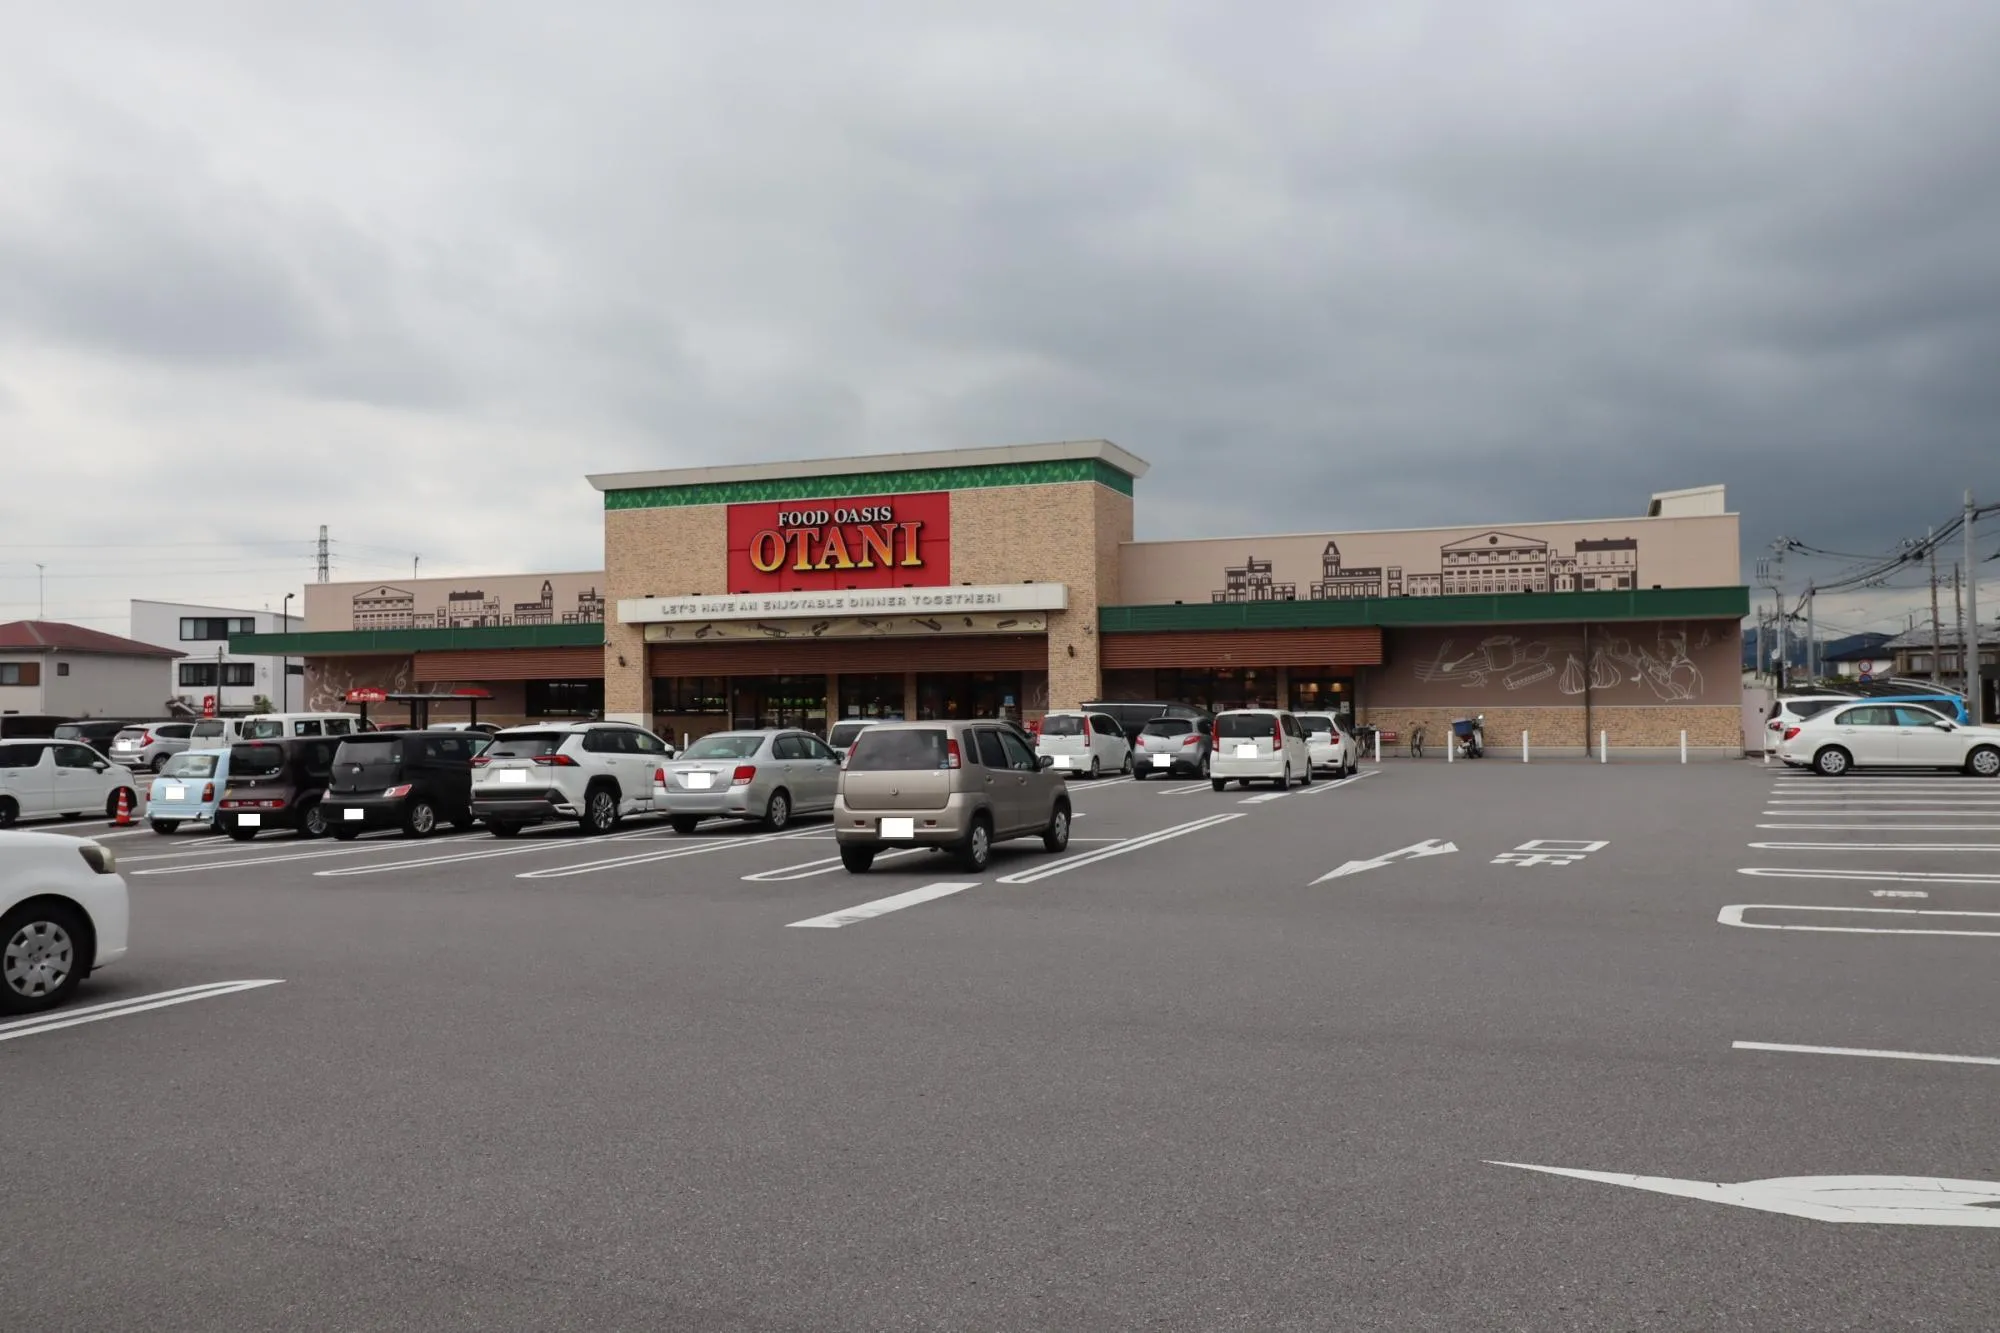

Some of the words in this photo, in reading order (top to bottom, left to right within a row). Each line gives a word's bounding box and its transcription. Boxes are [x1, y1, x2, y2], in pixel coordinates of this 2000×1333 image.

[778, 510, 829, 527] FOOD
[834, 506, 892, 524] OASIS
[750, 522, 922, 572] OTANI
[661, 604, 697, 615] LET'S
[702, 603, 736, 613] HAVE
[740, 602, 758, 612] AN
[763, 597, 844, 611] ENJOYABLE
[850, 596, 907, 608] DINNER
[912, 593, 1001, 606] TOGETHER!
